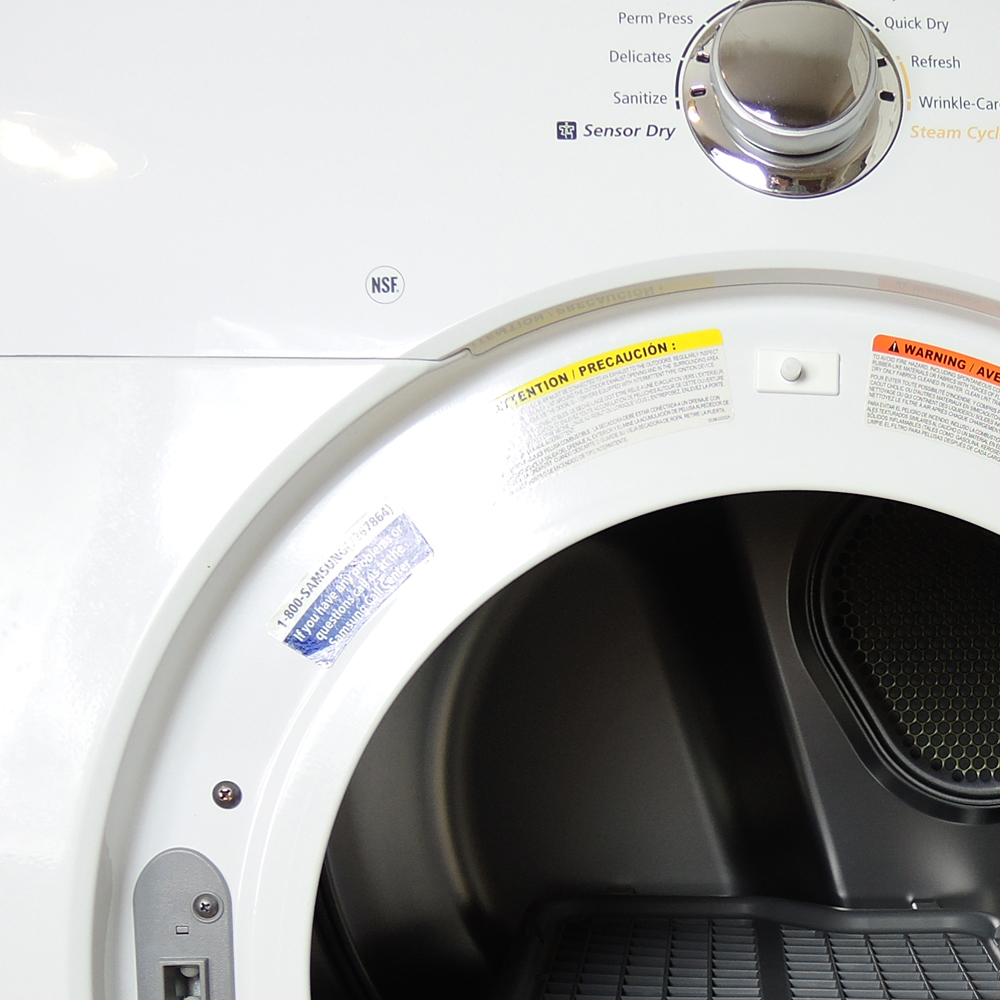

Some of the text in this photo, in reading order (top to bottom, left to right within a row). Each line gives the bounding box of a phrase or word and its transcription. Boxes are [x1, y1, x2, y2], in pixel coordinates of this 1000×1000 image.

[618, 11, 694, 25] Perm Press
[884, 16, 949, 33] Quick Dry
[609, 49, 672, 63] Delicates
[911, 55, 961, 69] Refresh
[613, 91, 668, 105] Sanitize
[583, 123, 677, 141] Sensor Dry
[910, 125, 962, 140] Steam
[371, 276, 398, 294] NSF
[577, 341, 667, 376] PRECAUCIÓN
[903, 344, 967, 370] WARNING
[293, 627, 306, 642] If
[302, 614, 321, 636] you
[314, 591, 339, 616] have
[391, 524, 404, 538] or
[329, 605, 367, 646] Samsung
[382, 560, 412, 590] Center
[316, 597, 355, 641] questions
